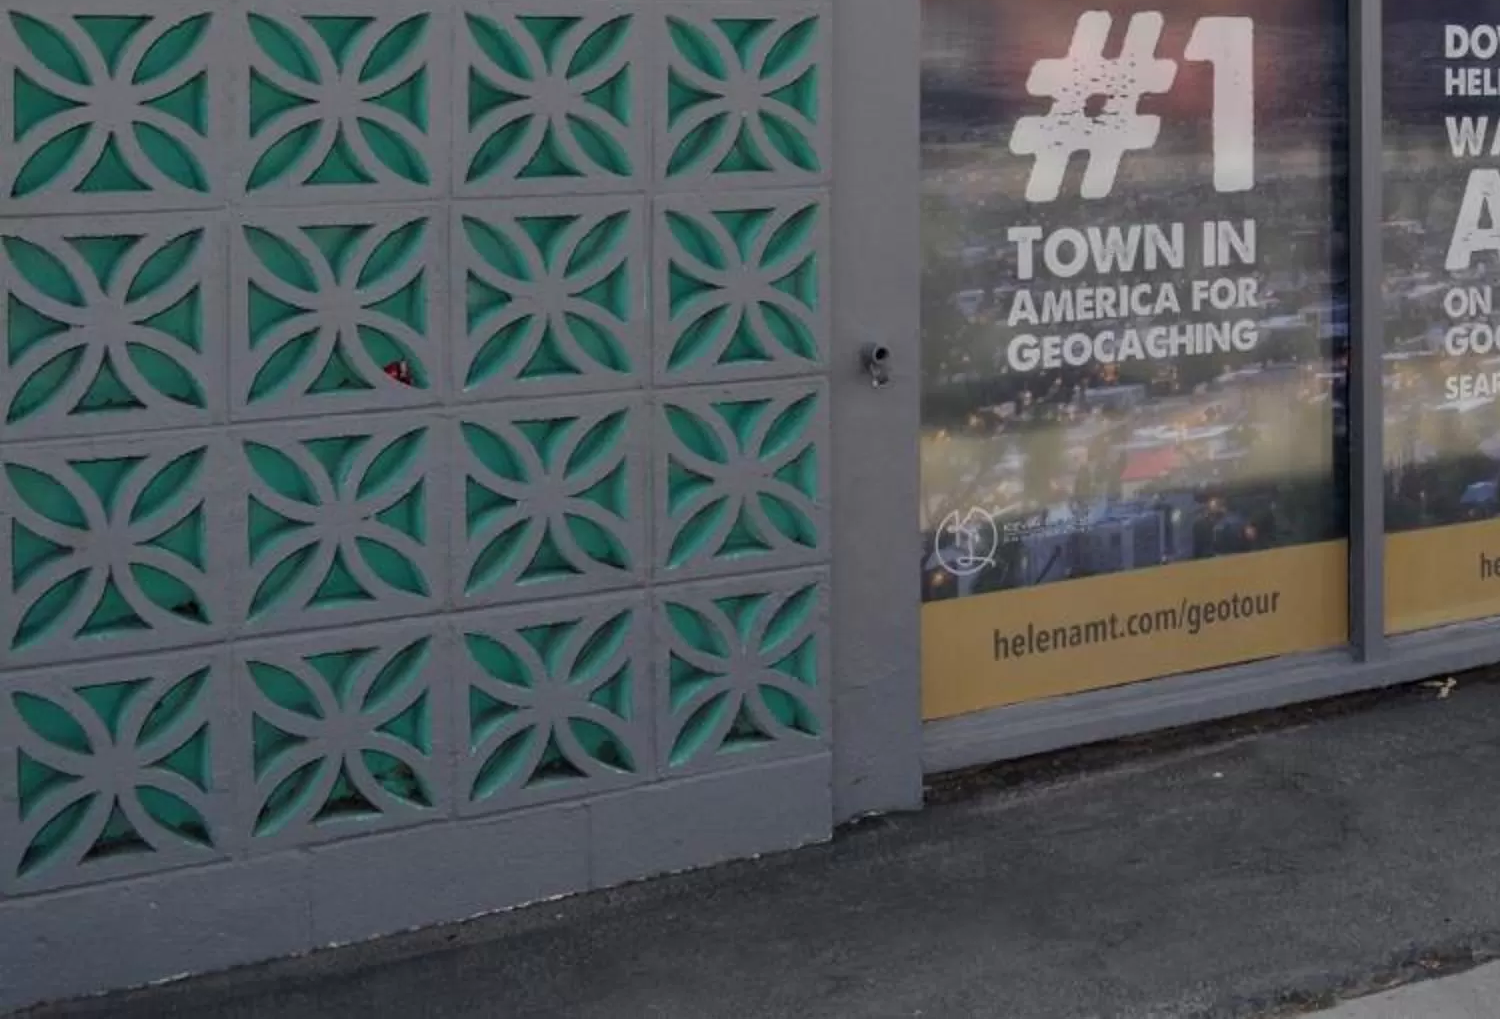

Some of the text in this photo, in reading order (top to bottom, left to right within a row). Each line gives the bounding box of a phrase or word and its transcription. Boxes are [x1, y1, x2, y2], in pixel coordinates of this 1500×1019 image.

[1009, 10, 1254, 202] #1
[1007, 218, 1257, 280] TOWN IN
[1007, 278, 1260, 327] AMERICA FOR
[1444, 285, 1493, 318] ON
[1007, 319, 1260, 372] GEOCACHING
[993, 591, 1281, 662] helenamt.com/geotour
